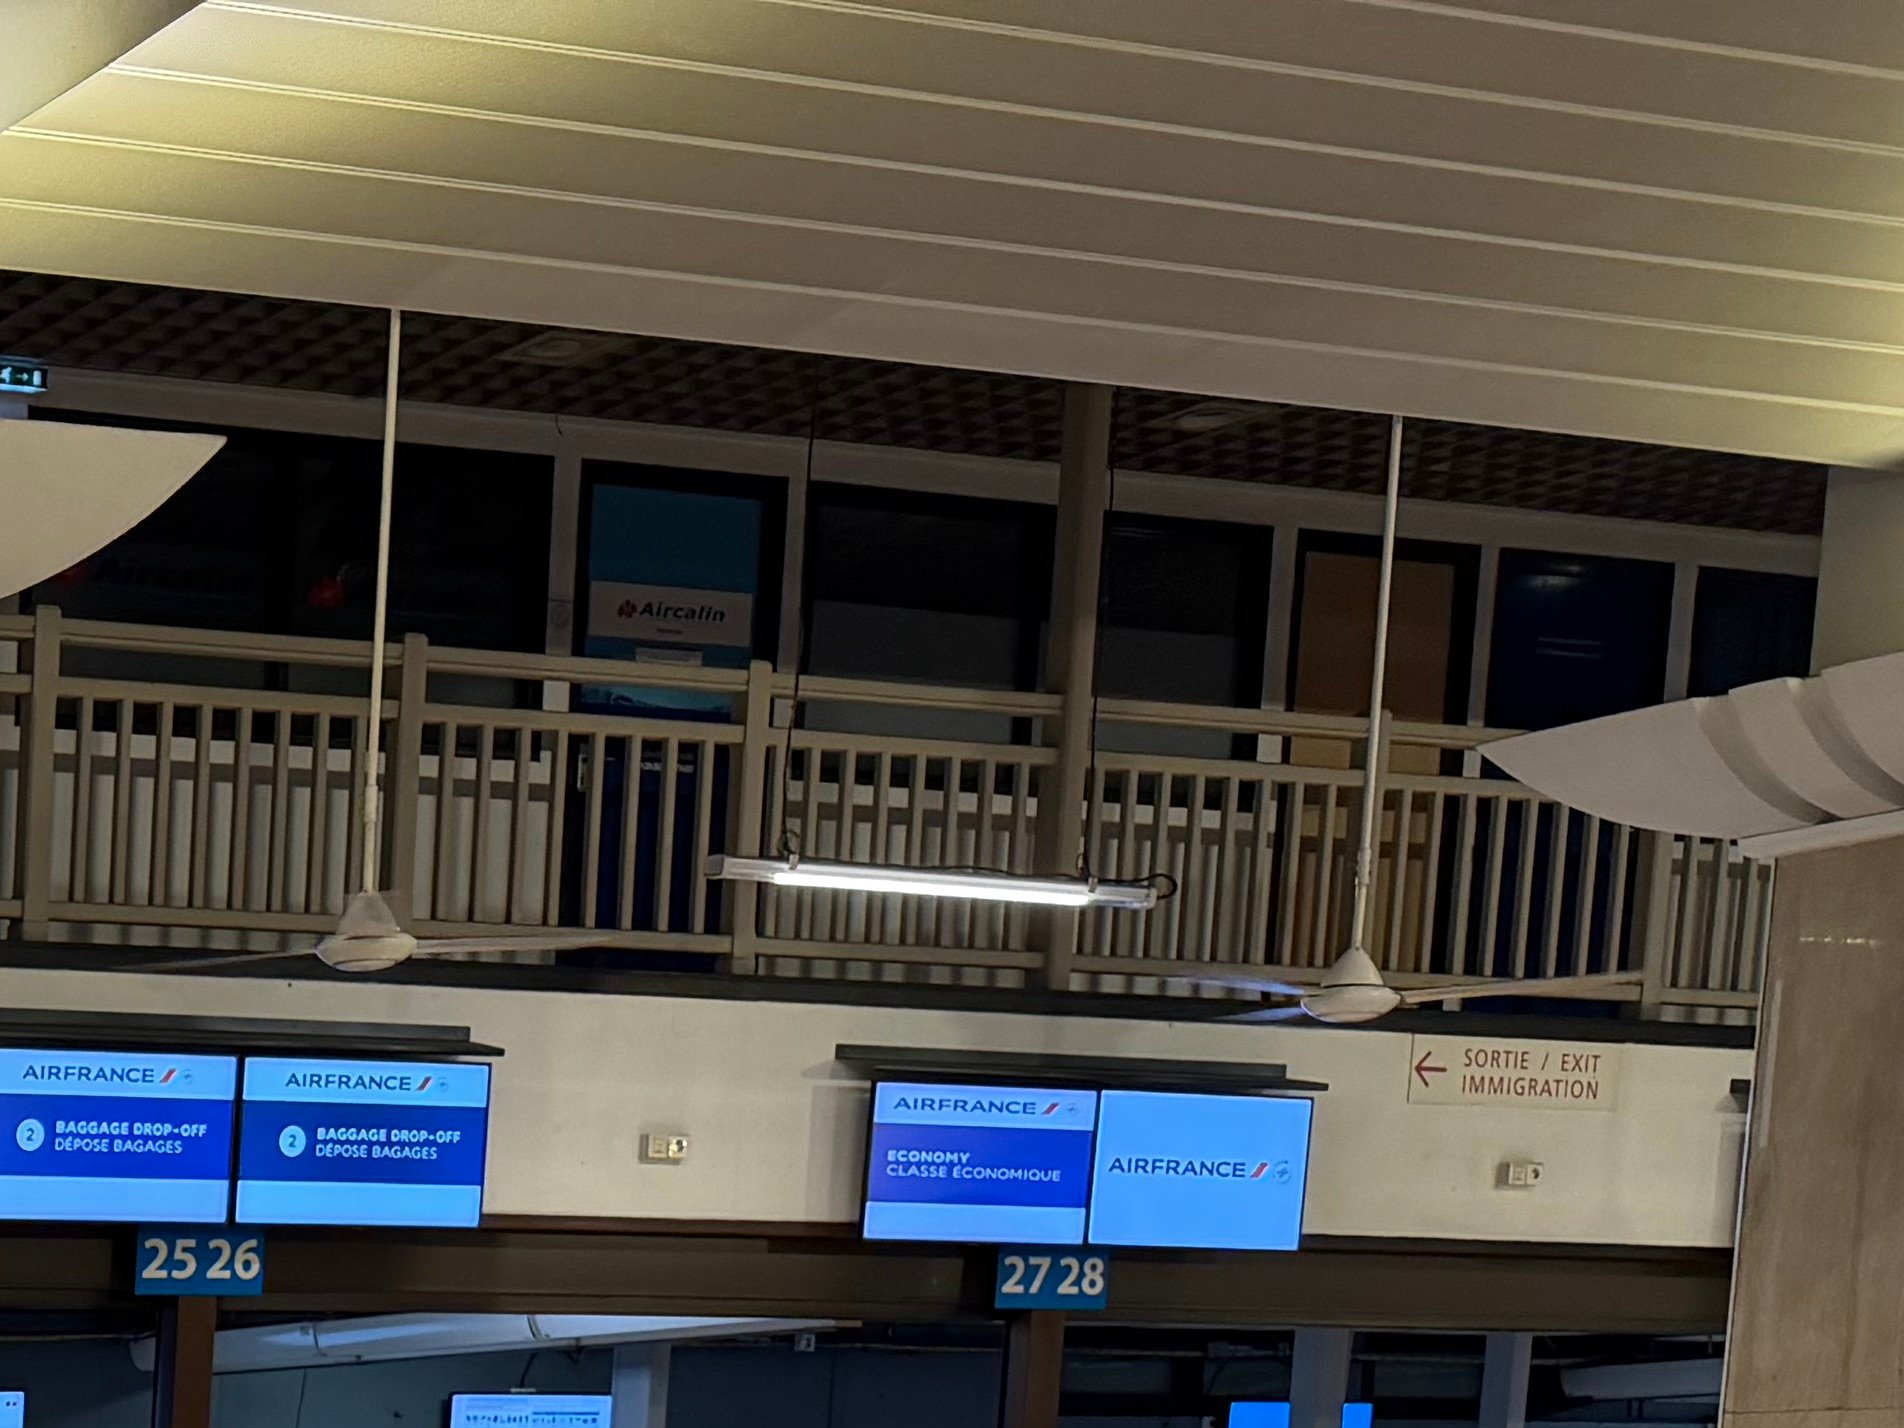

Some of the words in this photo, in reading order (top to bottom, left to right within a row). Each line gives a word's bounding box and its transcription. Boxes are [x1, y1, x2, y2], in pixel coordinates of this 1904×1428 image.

[639, 601, 727, 622] Aircalin
[1463, 1047, 1530, 1072] SORTIE
[1541, 1051, 1550, 1072] /
[1560, 1053, 1602, 1074] EXIT
[22, 1065, 155, 1084] AIRFRANCE
[285, 1072, 412, 1092] AIRFRANCE
[1461, 1075, 1600, 1100] IMMIGRATION
[893, 1096, 1037, 1115] AIRFRANCE
[55, 1120, 130, 1136] BAGGAGE
[133, 1121, 208, 1138] DROP-OFF
[316, 1127, 387, 1143] BAGGAGE
[390, 1129, 461, 1144] DROP-OFF
[54, 1136, 109, 1153] DÉPOSE
[113, 1139, 183, 1155] BAGAGES
[315, 1142, 369, 1159] DÉPOSE
[371, 1145, 438, 1160] BAGAGES
[887, 1150, 971, 1165] ECONOMY
[886, 1164, 948, 1178] CLASSE
[952, 1164, 1062, 1182] ÉCONOMIQUE
[1108, 1157, 1247, 1179] AIRFRANCE
[141, 1237, 197, 1282] 25
[206, 1237, 261, 1283] 26
[1000, 1256, 1053, 1295] 27
[1056, 1256, 1105, 1295] 28
